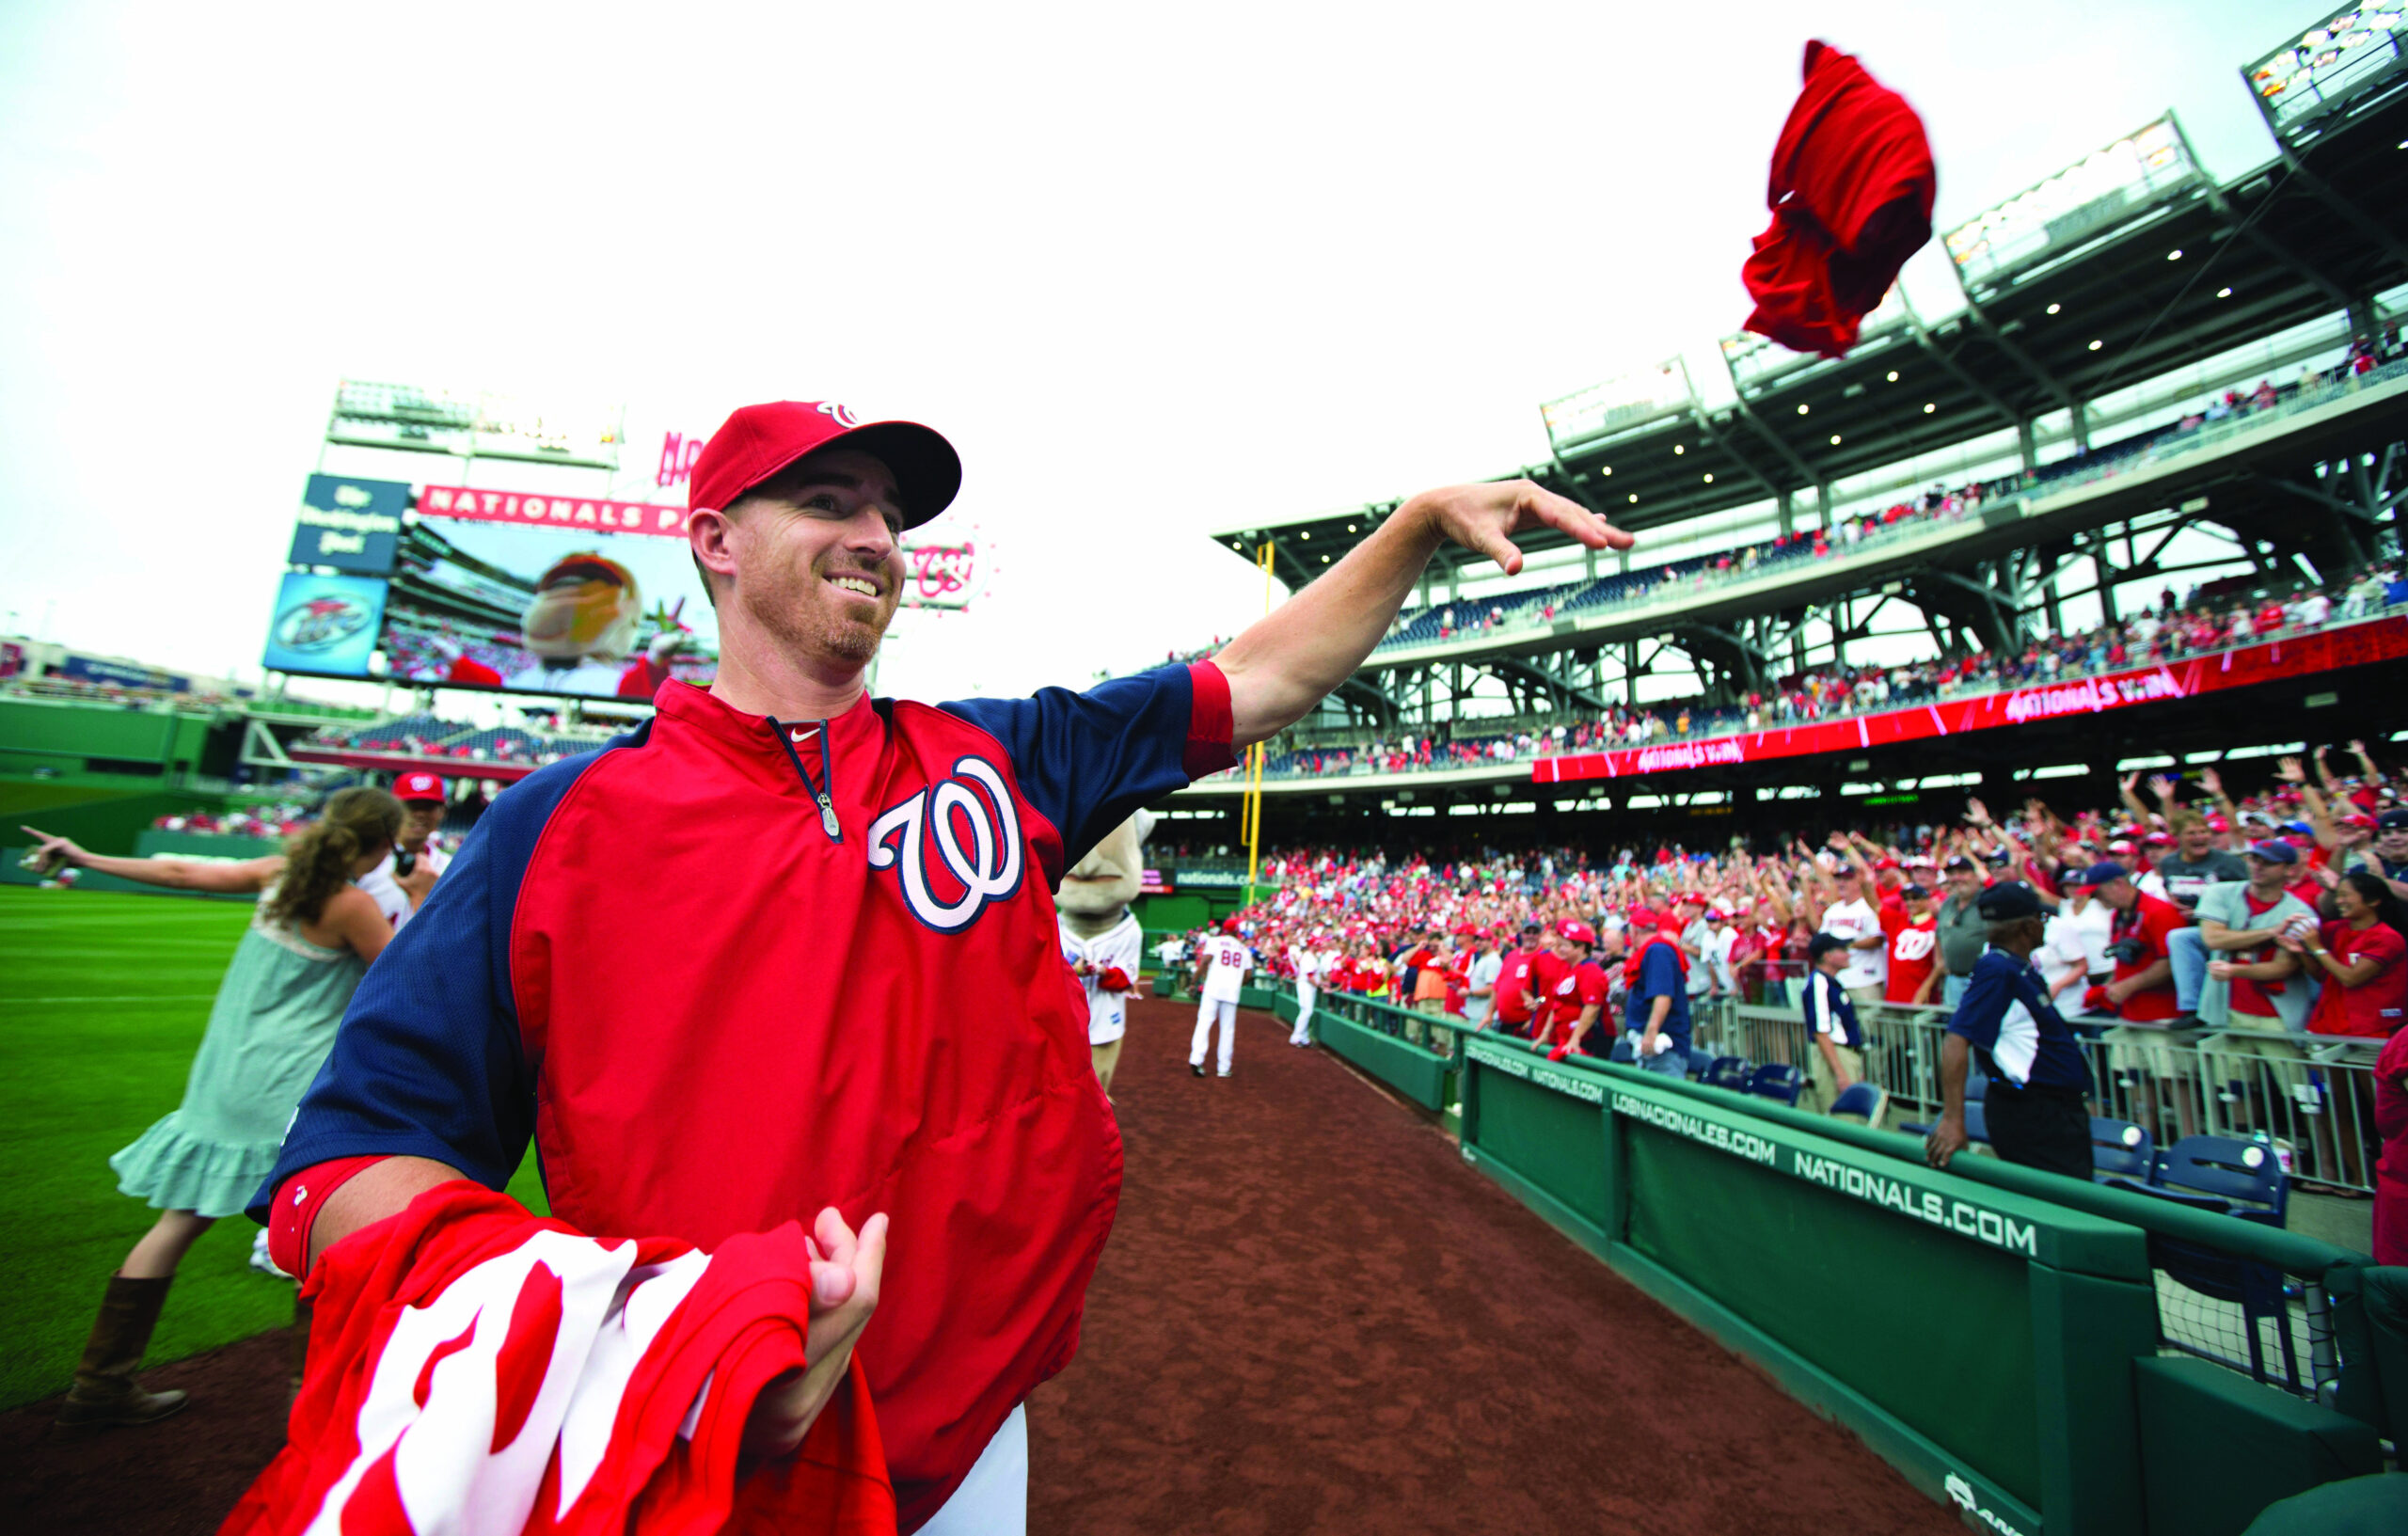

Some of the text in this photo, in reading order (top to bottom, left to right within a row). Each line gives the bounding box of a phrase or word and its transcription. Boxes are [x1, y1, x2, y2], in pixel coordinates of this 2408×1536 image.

[428, 488, 642, 528] NATIONALS
[1176, 870, 1254, 885] nationals.co
[1221, 949, 1242, 969] 88
[1531, 1068, 1604, 1104] NATIONALS.COM
[1611, 1092, 1776, 1166] LOSNACIONALES.COM
[1794, 1150, 2037, 1257] NATIONALS.COM
